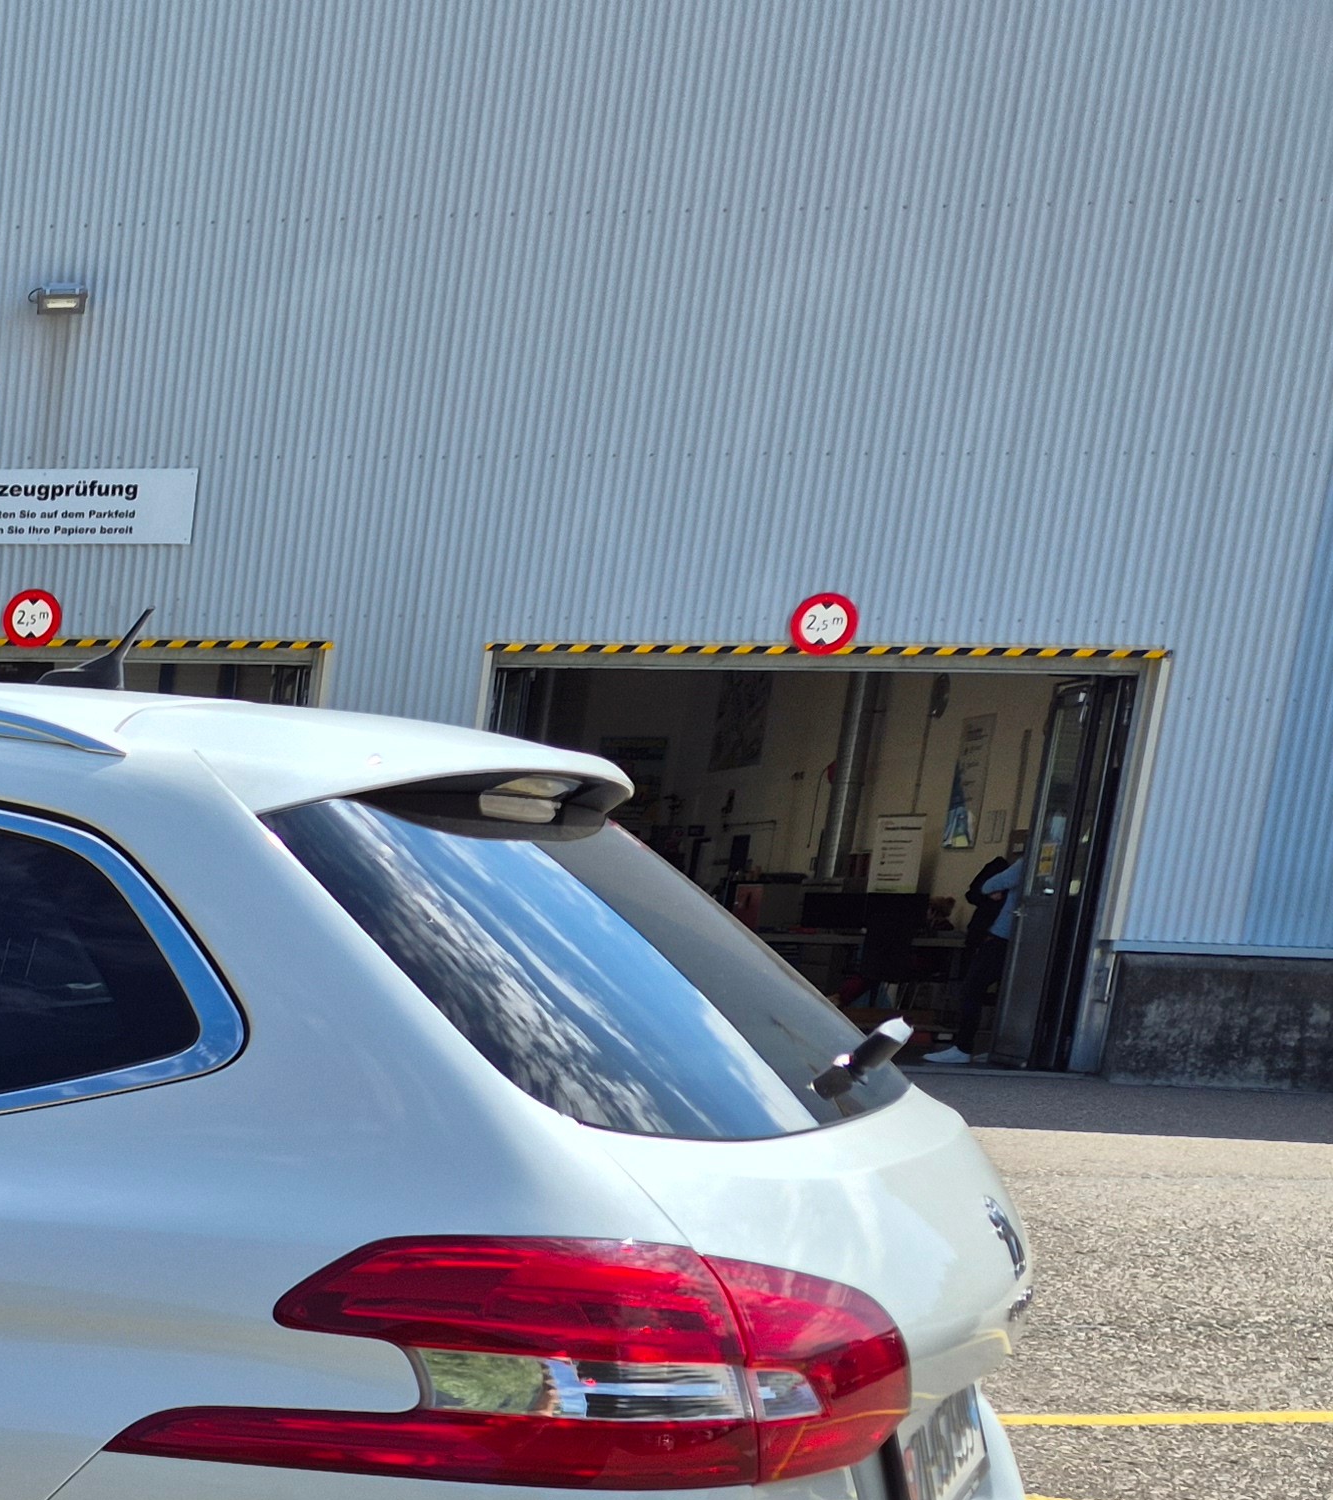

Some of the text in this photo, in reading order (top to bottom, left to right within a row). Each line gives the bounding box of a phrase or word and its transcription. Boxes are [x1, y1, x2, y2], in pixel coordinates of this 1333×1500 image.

[19, 510, 37, 519] Sie
[40, 510, 59, 519] auf
[61, 510, 85, 519] dem
[89, 510, 136, 519] Parkfeld
[7, 526, 25, 535] Sie
[28, 526, 51, 535] Ihre
[54, 526, 96, 536] Papiere
[100, 526, 133, 535] bereit
